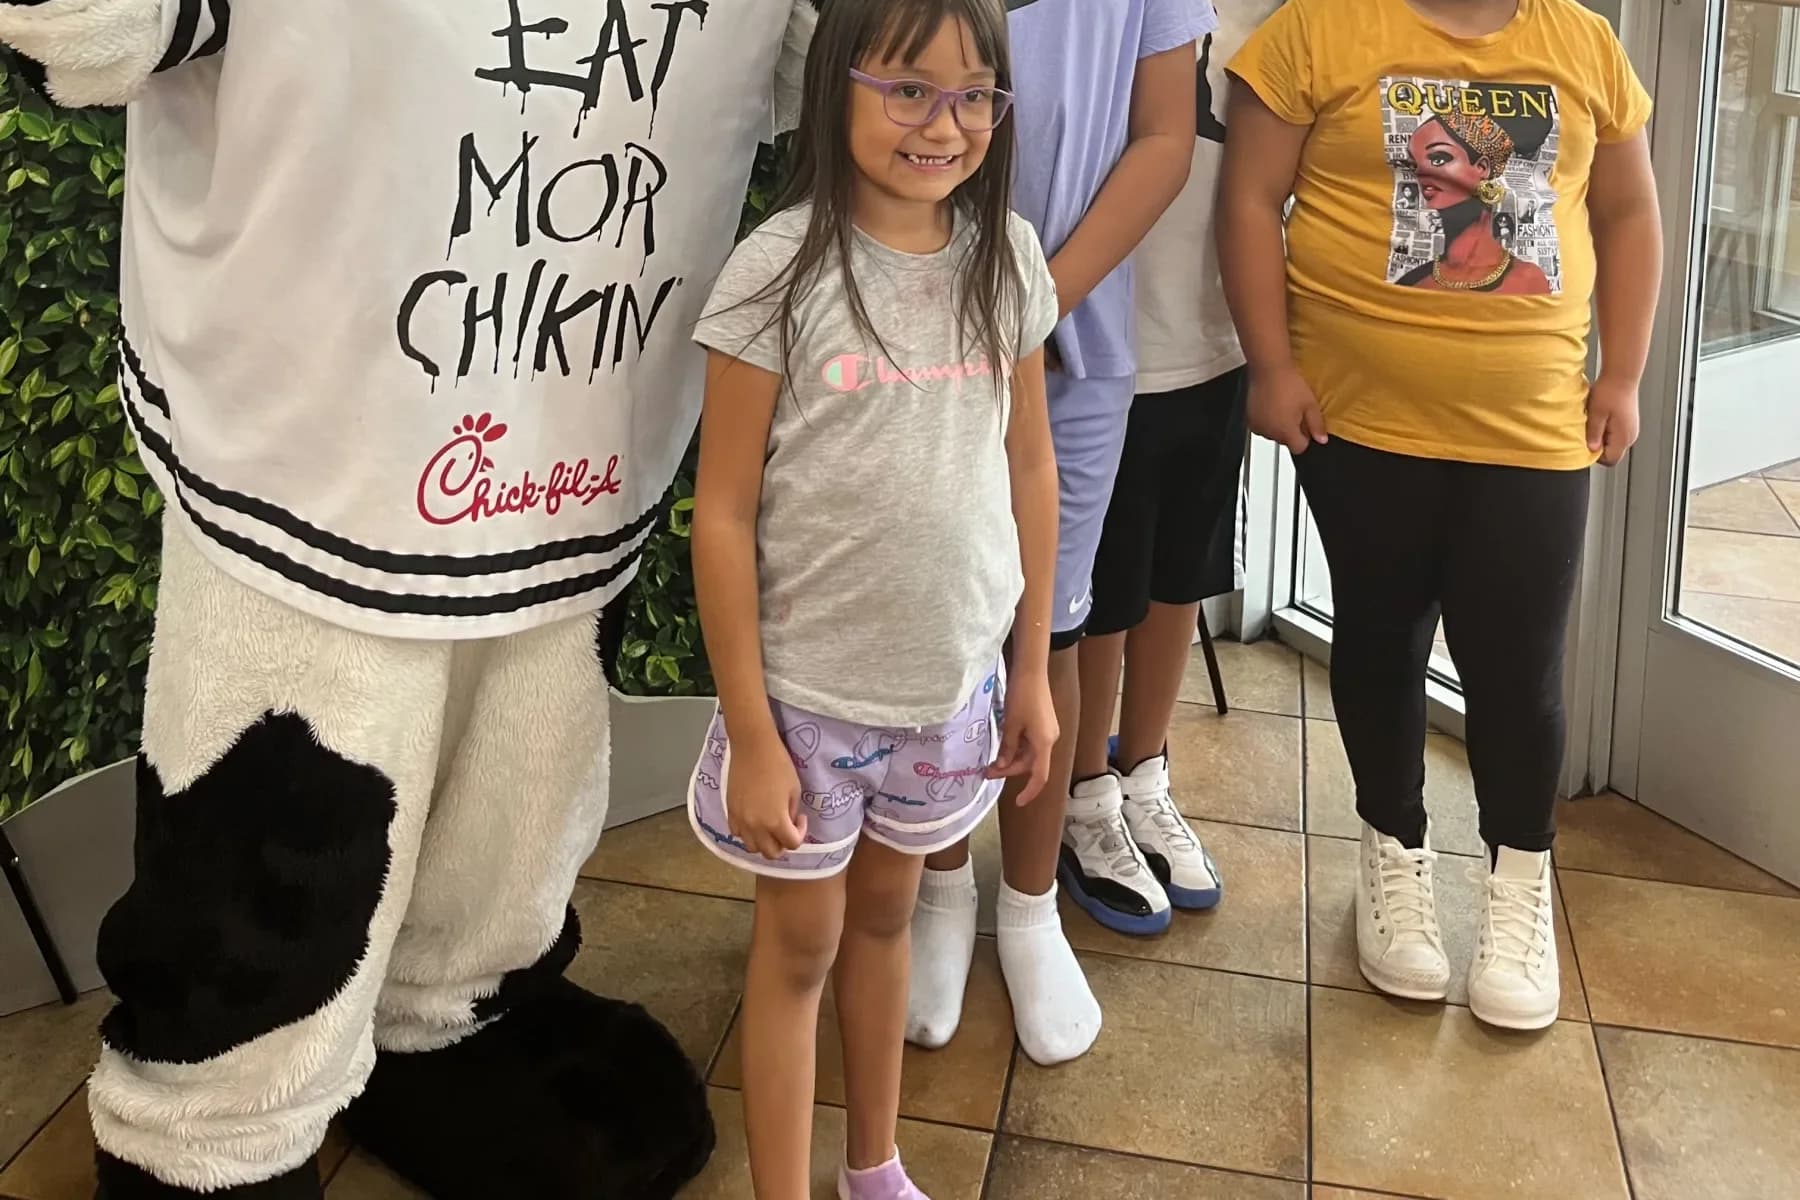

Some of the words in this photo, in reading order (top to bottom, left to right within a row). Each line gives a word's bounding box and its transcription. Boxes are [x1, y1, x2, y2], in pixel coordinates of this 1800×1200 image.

[1387, 81, 1549, 120] QUEEN
[447, 131, 667, 277] MOR
[397, 259, 677, 394] CHIKIN
[417, 414, 621, 525] Chick-fil-A
